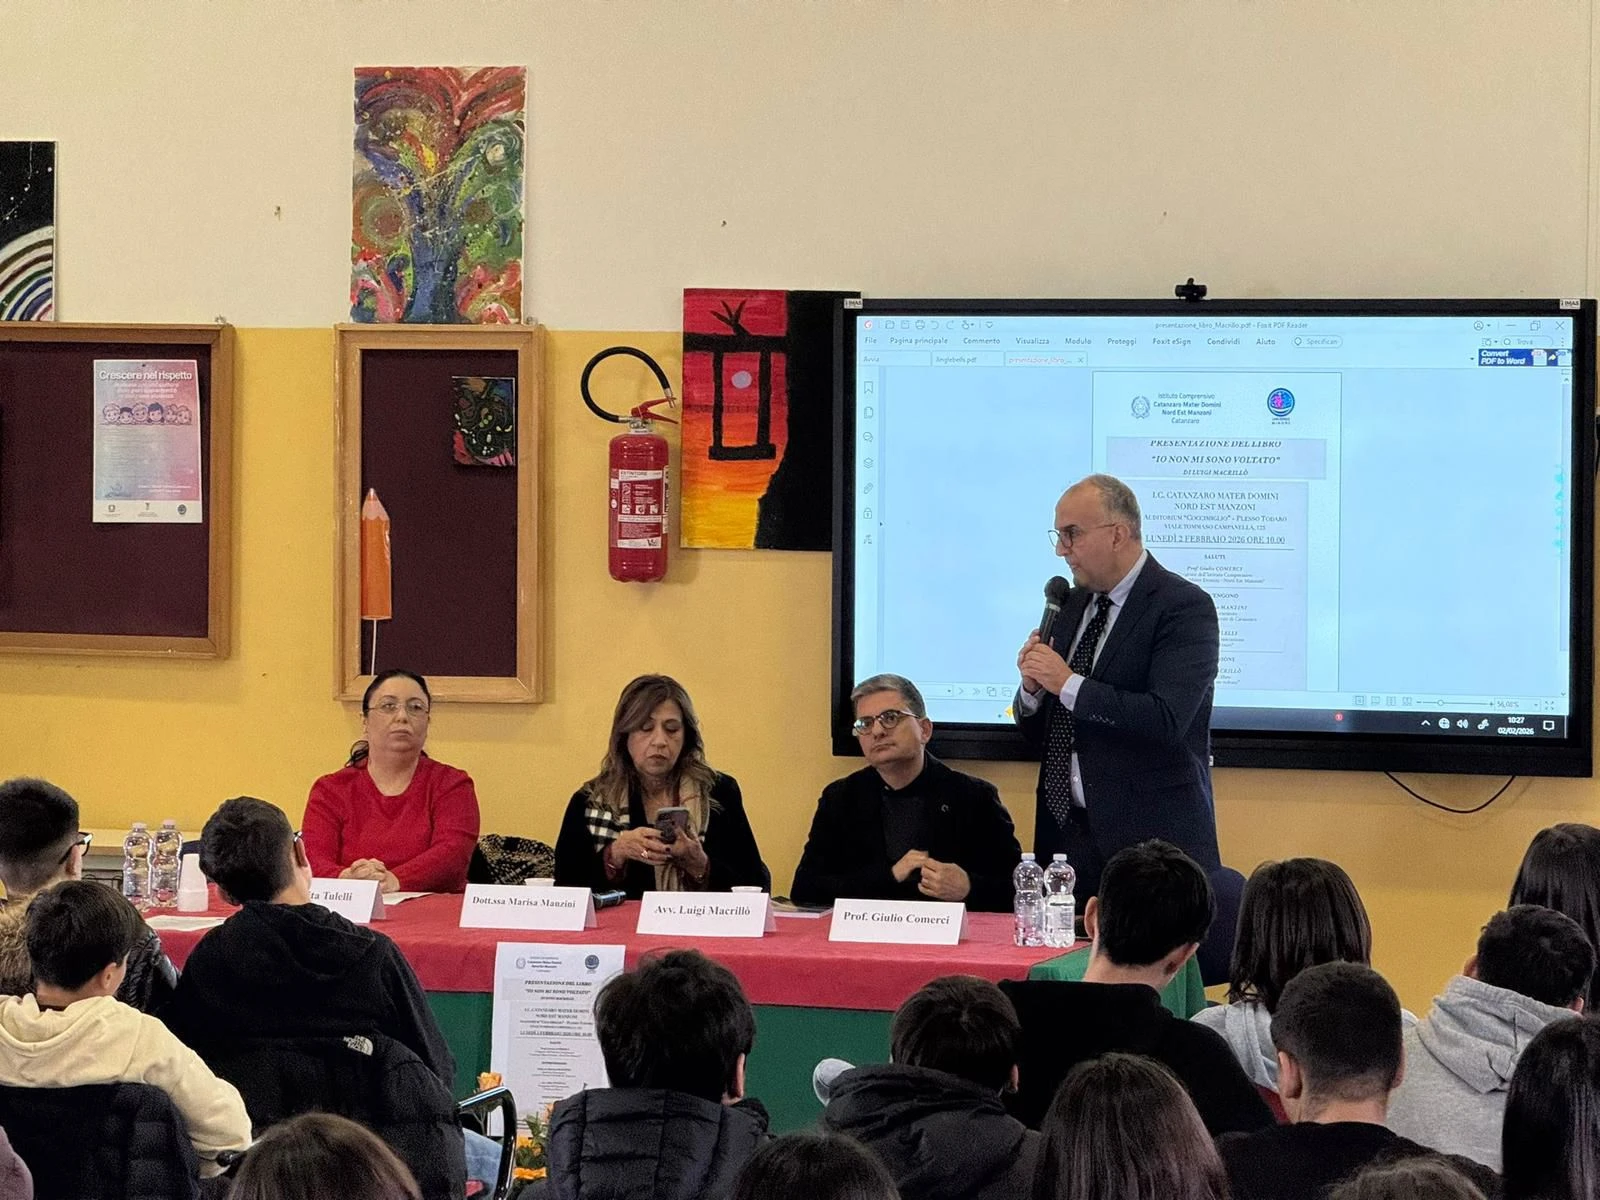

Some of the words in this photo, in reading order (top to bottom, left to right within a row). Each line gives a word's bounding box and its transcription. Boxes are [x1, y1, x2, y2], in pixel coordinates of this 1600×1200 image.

[890, 337, 913, 345] Pagina
[914, 337, 948, 345] principale
[1107, 338, 1137, 346] Proteggi
[1172, 338, 1192, 346] eSign
[100, 370, 142, 380] Crescere
[143, 370, 157, 380] nel
[159, 371, 192, 382] rispetto
[1498, 727, 1534, 735] 02/02/2026
[323, 891, 352, 901] Tulelli
[472, 896, 505, 905] Dott.ssa
[509, 898, 538, 906] Marisa
[541, 899, 576, 908] Manzini
[654, 906, 676, 914] Avv.
[679, 906, 706, 916] Luigi
[708, 906, 750, 915] Macrillò
[844, 912, 868, 921] Prof.
[871, 913, 903, 922] Giulio
[906, 914, 950, 924] Comerci
